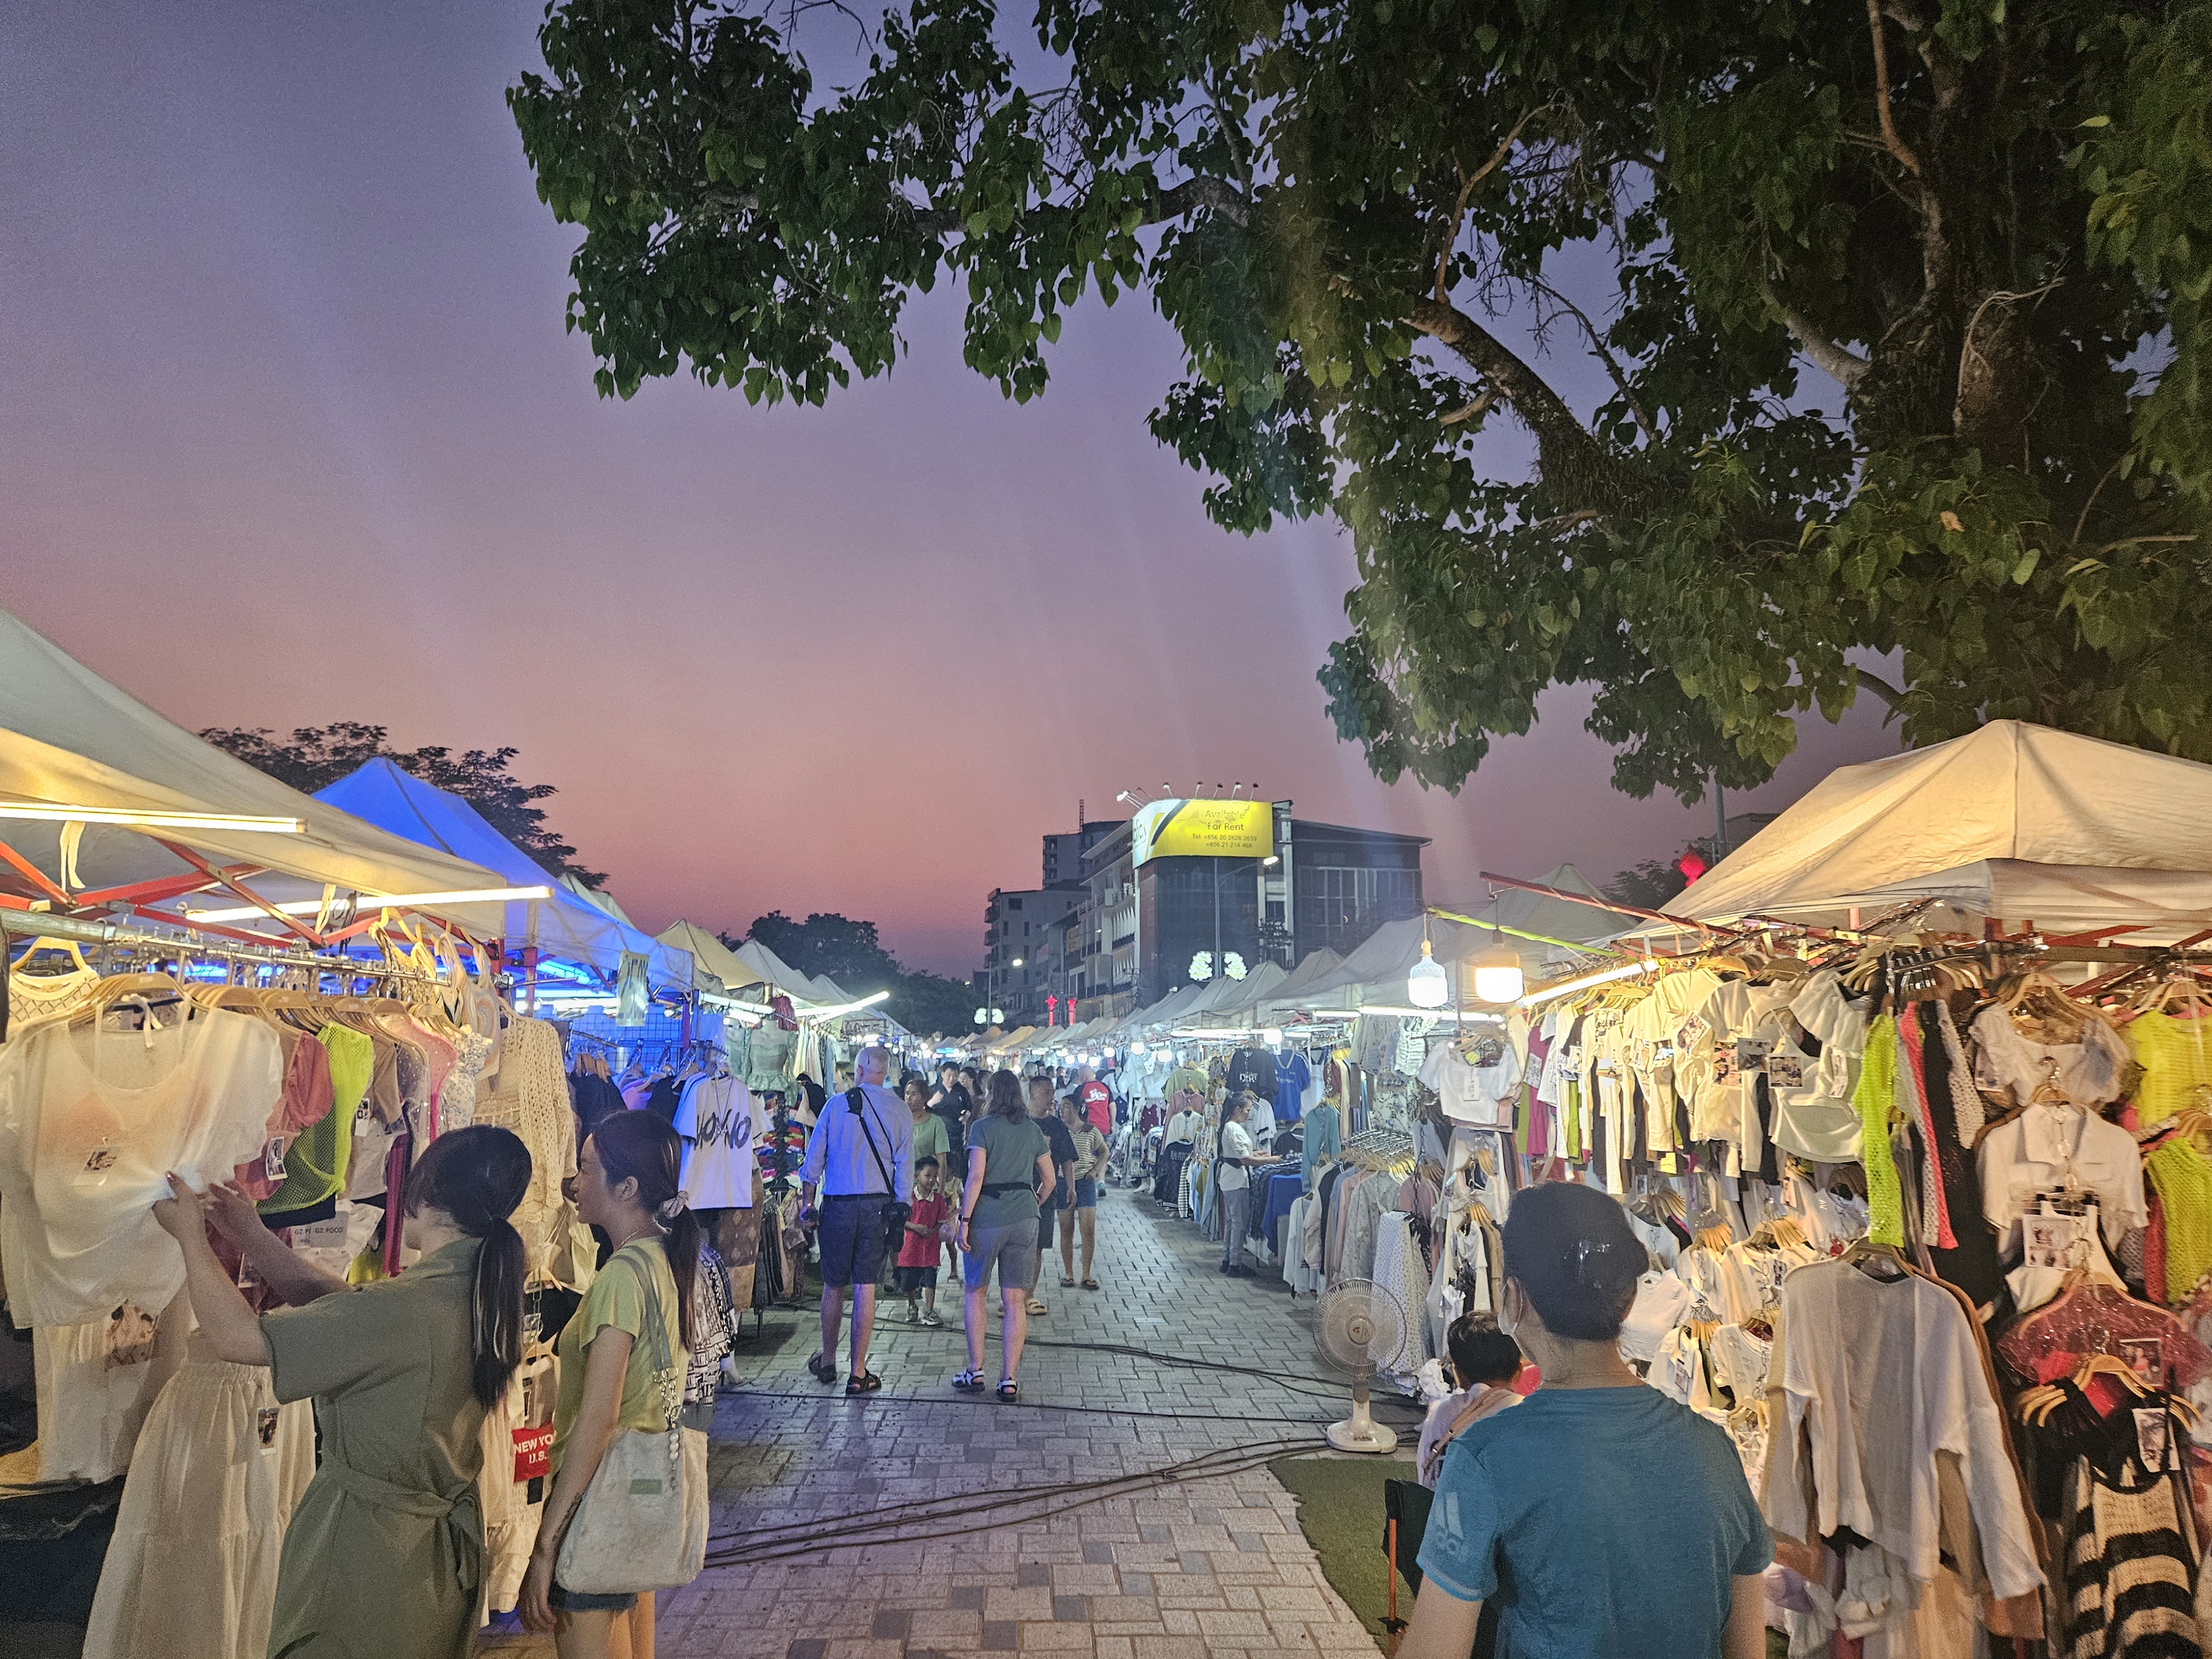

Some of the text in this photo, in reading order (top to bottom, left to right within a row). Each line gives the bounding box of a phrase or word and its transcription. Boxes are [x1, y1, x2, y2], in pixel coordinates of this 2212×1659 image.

[1205, 810, 1245, 819] Available
[1208, 822, 1244, 831] For Rent
[513, 1434, 554, 1454] NEW YO
[529, 1451, 549, 1464] U.S.
